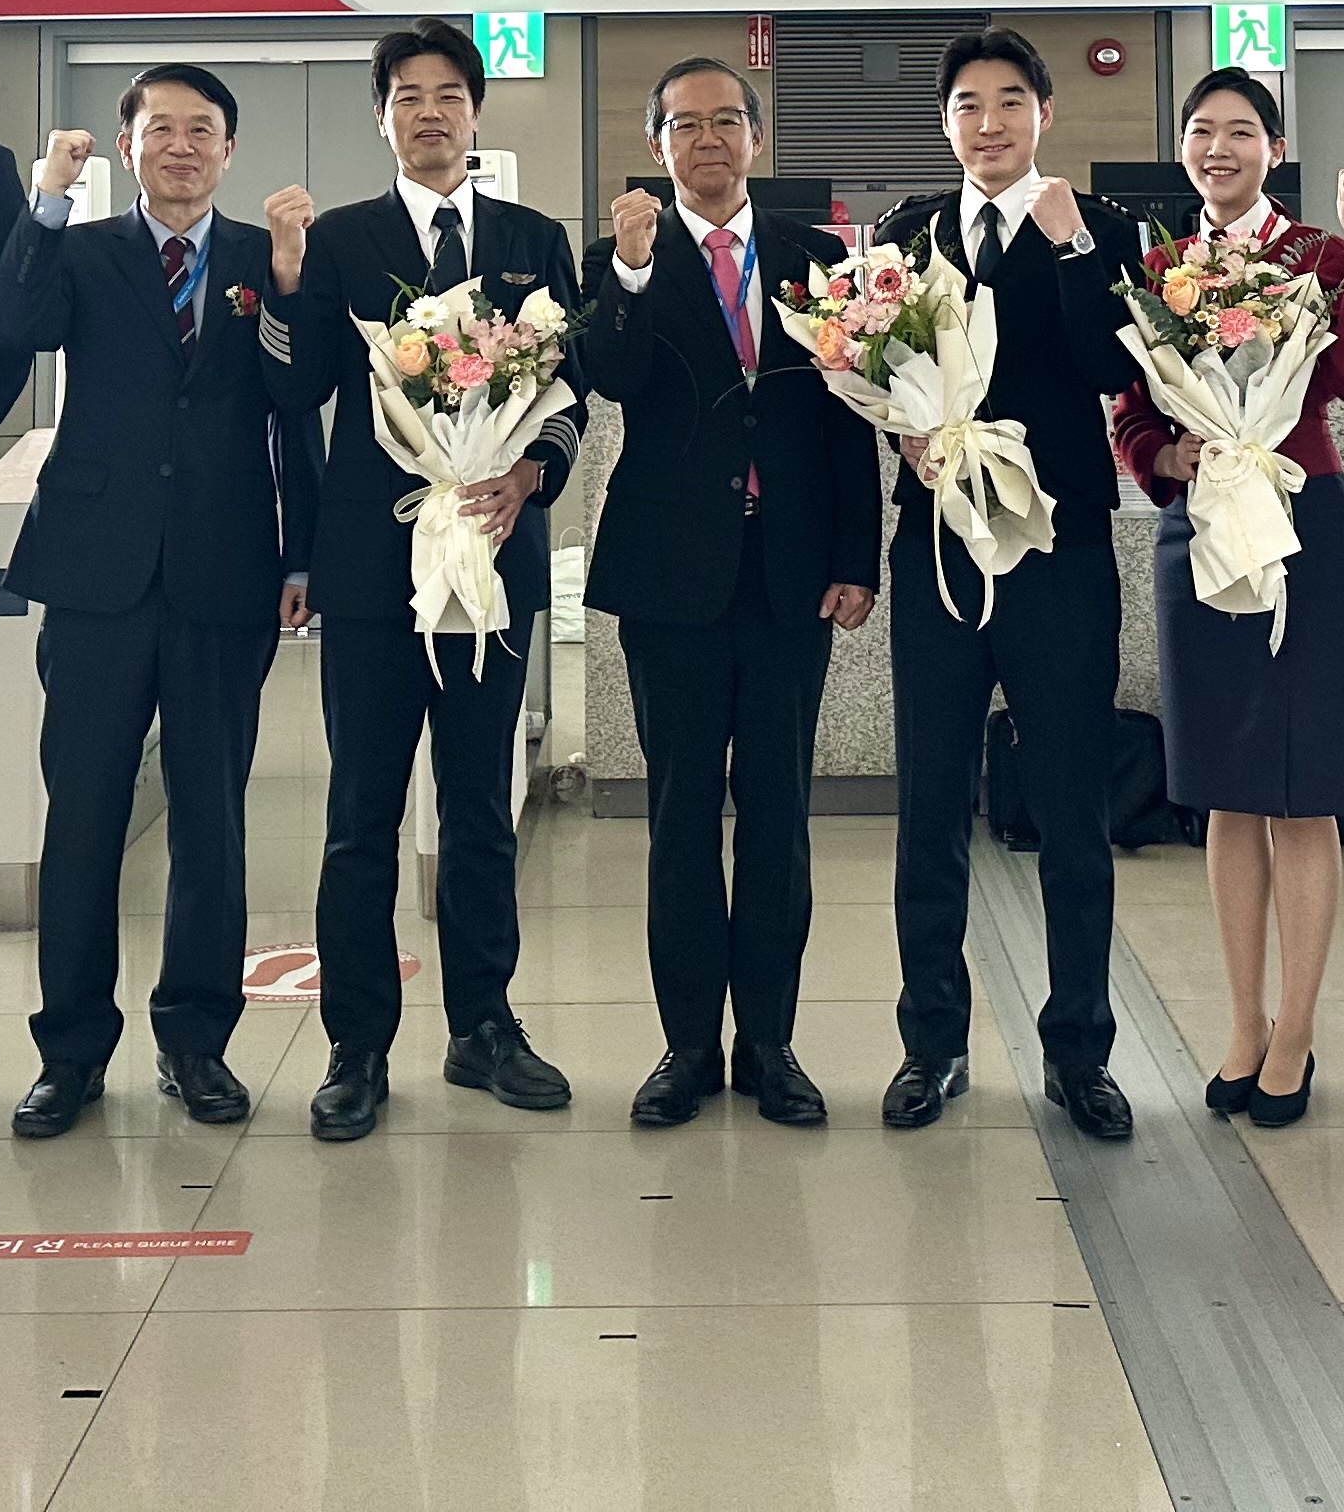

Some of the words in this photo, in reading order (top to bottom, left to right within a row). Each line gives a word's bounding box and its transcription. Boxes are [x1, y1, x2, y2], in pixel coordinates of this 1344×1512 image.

[73, 1240, 133, 1249] PLEASE
[138, 1240, 191, 1248] QUEUE
[194, 1239, 237, 1247] HERE
